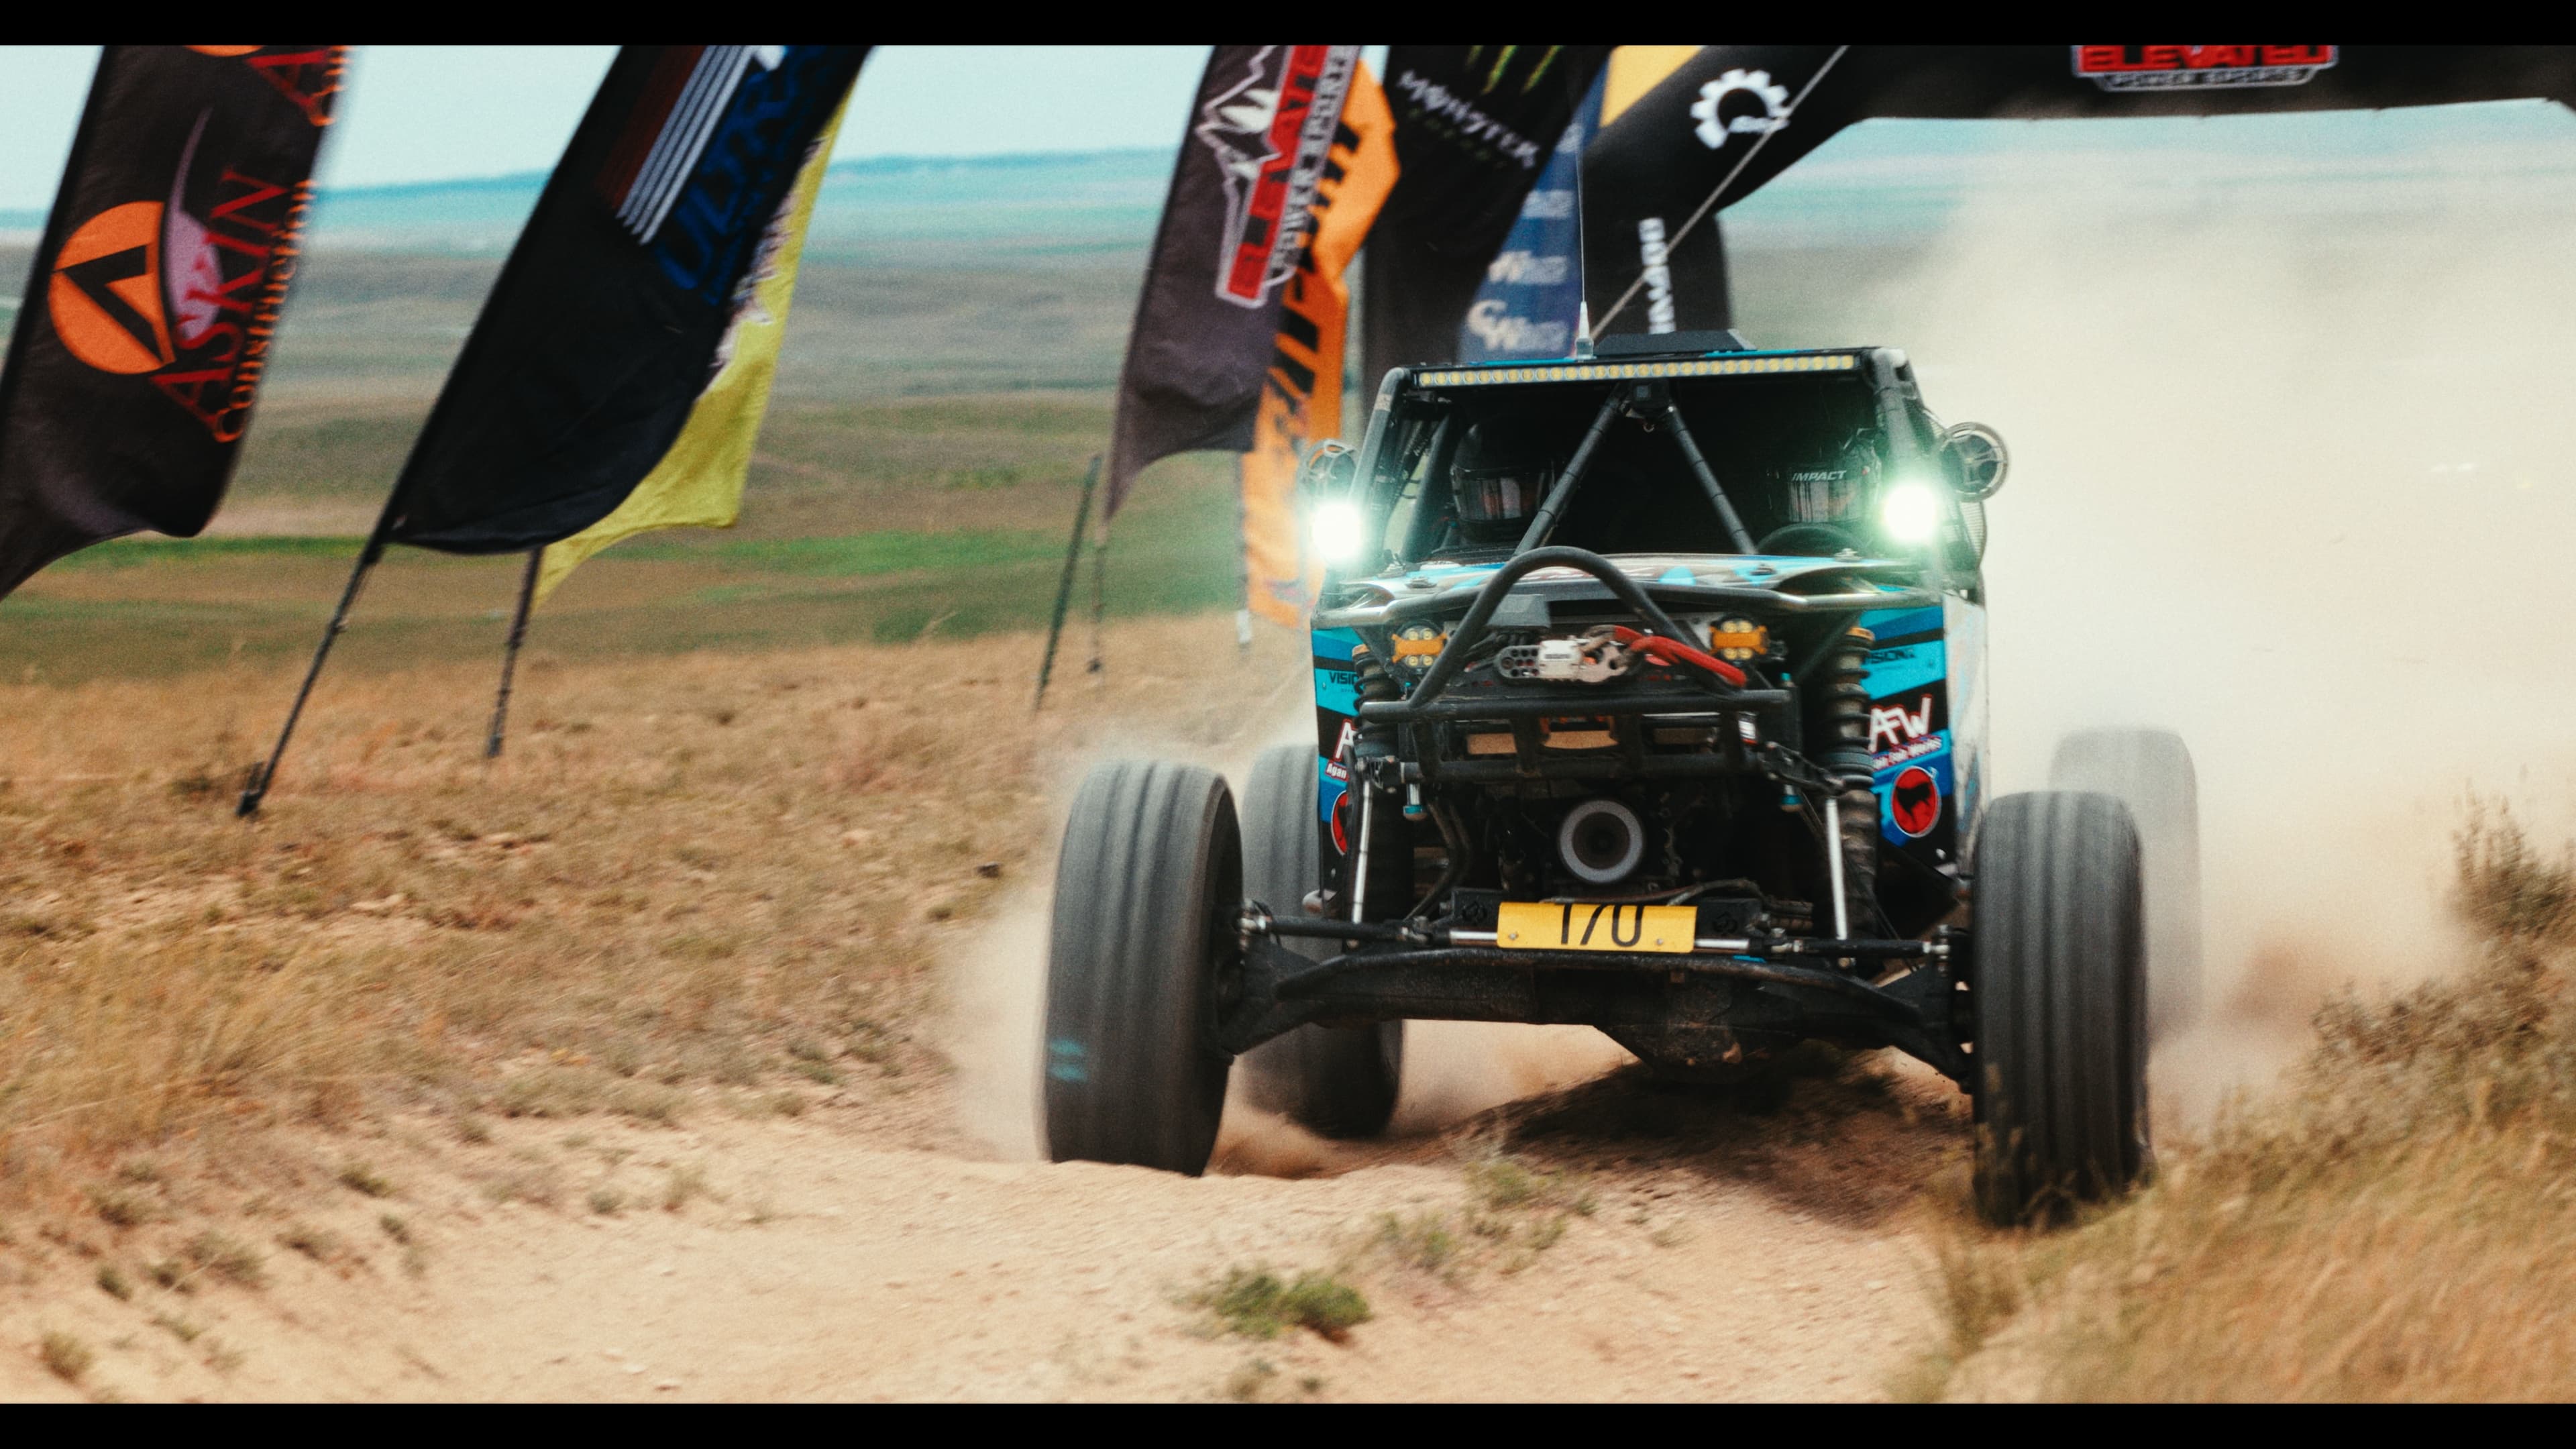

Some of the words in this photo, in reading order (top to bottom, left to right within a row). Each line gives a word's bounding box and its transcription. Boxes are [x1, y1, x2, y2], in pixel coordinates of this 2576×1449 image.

[1395, 70, 1540, 169] MONSTER
[149, 166, 288, 429] ASKIN
[214, 179, 316, 443] Construction
[1791, 470, 1847, 482] IMPACT
[1867, 695, 1933, 753] AFW
